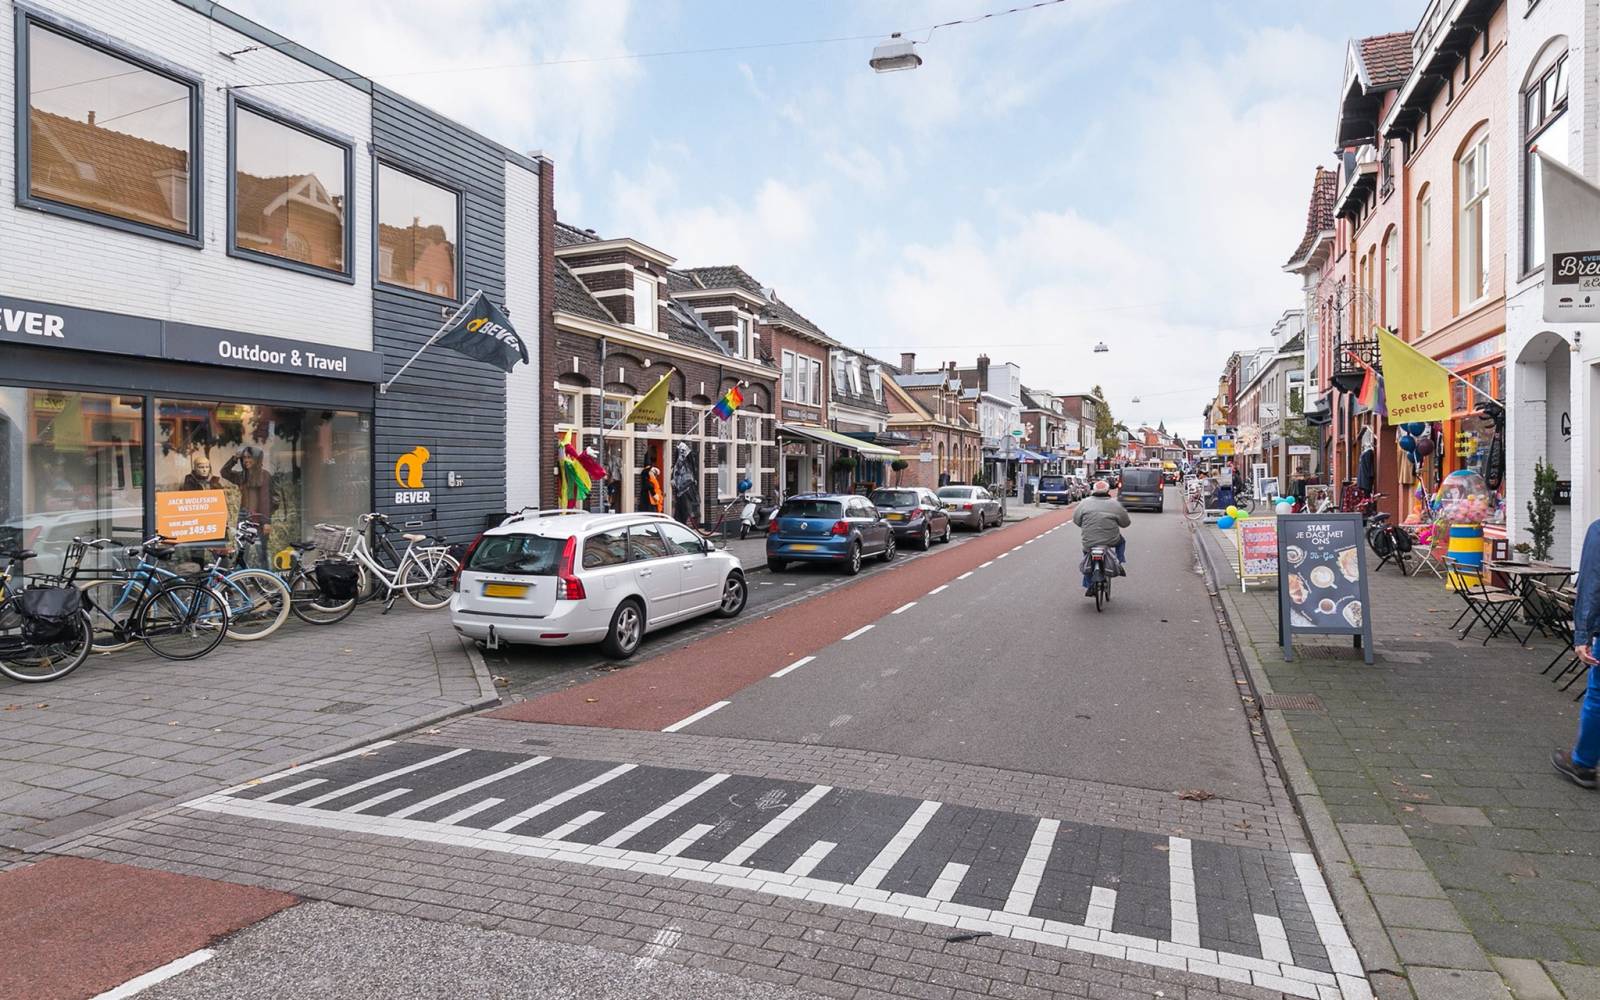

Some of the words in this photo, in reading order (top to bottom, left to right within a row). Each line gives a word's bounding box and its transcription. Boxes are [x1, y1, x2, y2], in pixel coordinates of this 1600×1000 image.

[0, 308, 65, 338] VER
[218, 340, 286, 365] Outdoor
[290, 349, 302, 367] &
[305, 352, 347, 372] Travel
[1400, 391, 1429, 402] Beter
[1391, 400, 1445, 417] Speelgoed
[395, 491, 430, 504] BEVER
[1305, 531, 1326, 539] DAG
[1327, 530, 1344, 538] MET
[1311, 537, 1330, 545] ONS
